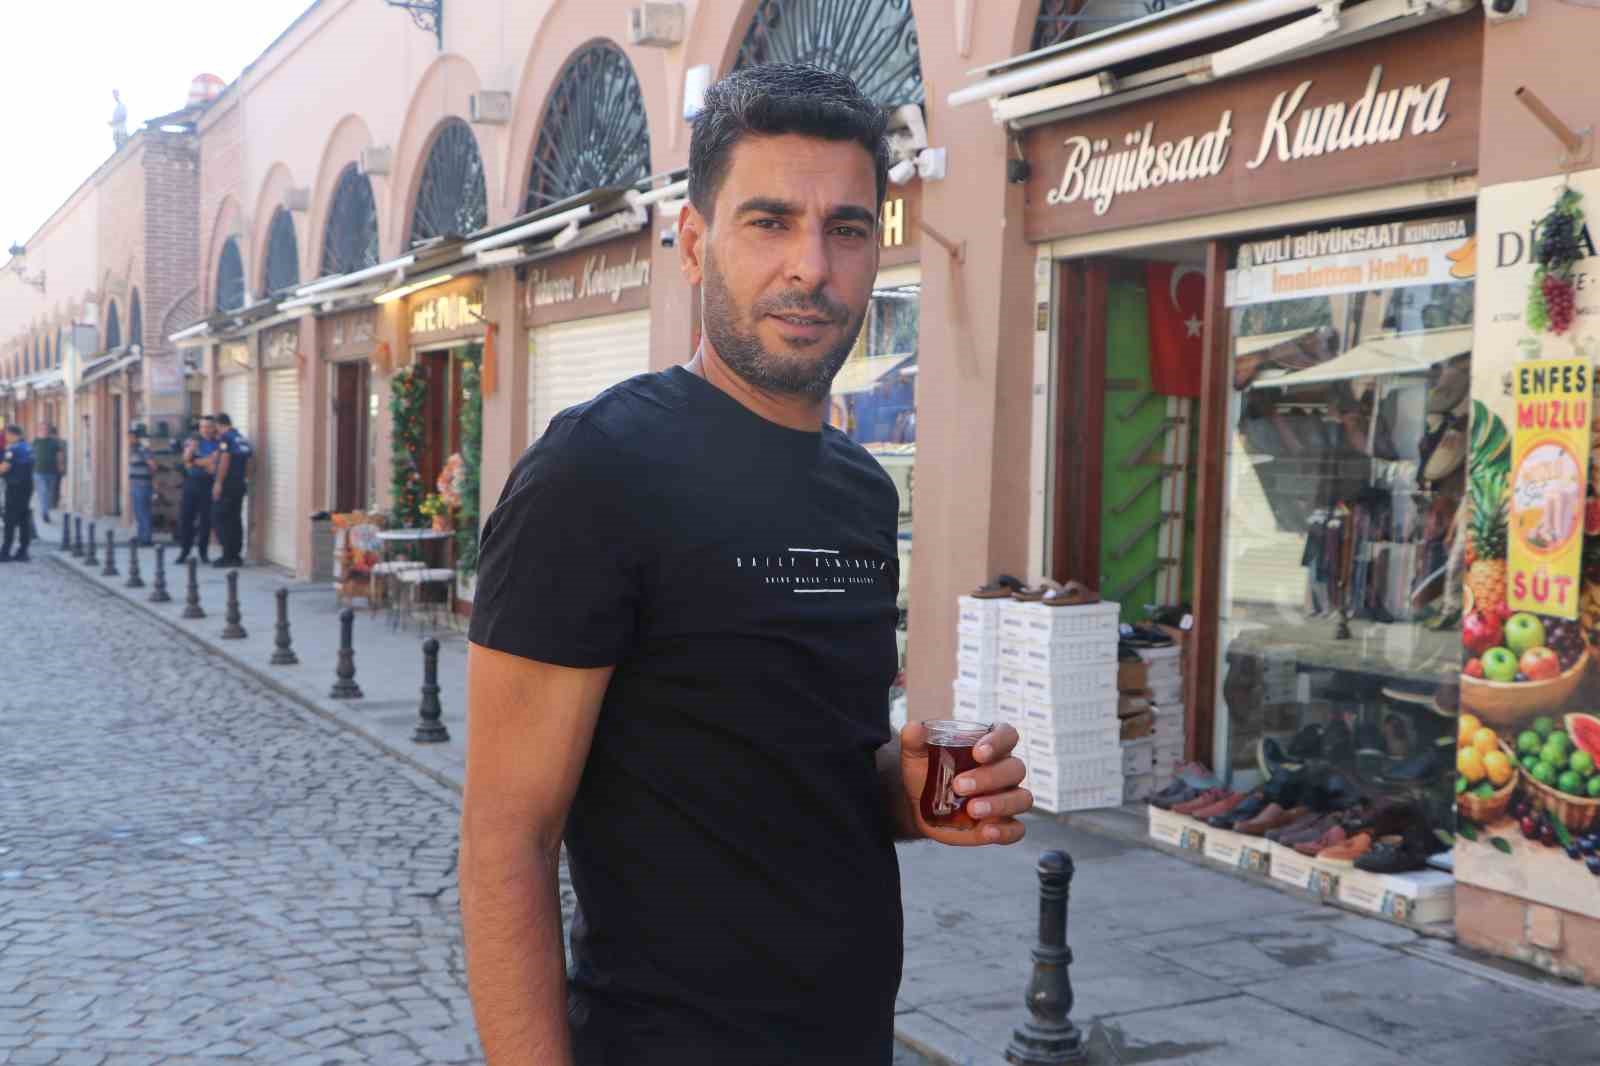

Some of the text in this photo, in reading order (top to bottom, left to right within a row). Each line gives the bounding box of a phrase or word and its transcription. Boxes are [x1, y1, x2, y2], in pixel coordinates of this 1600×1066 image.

[1047, 64, 1451, 216] Büyüksaat Kundura
[1294, 222, 1405, 258] BÜYÜKSAAT
[1406, 220, 1467, 243] KUNDURA
[1520, 365, 1587, 395] ENFES
[1518, 399, 1586, 429] MUZLU
[1513, 566, 1573, 604] SÜT
